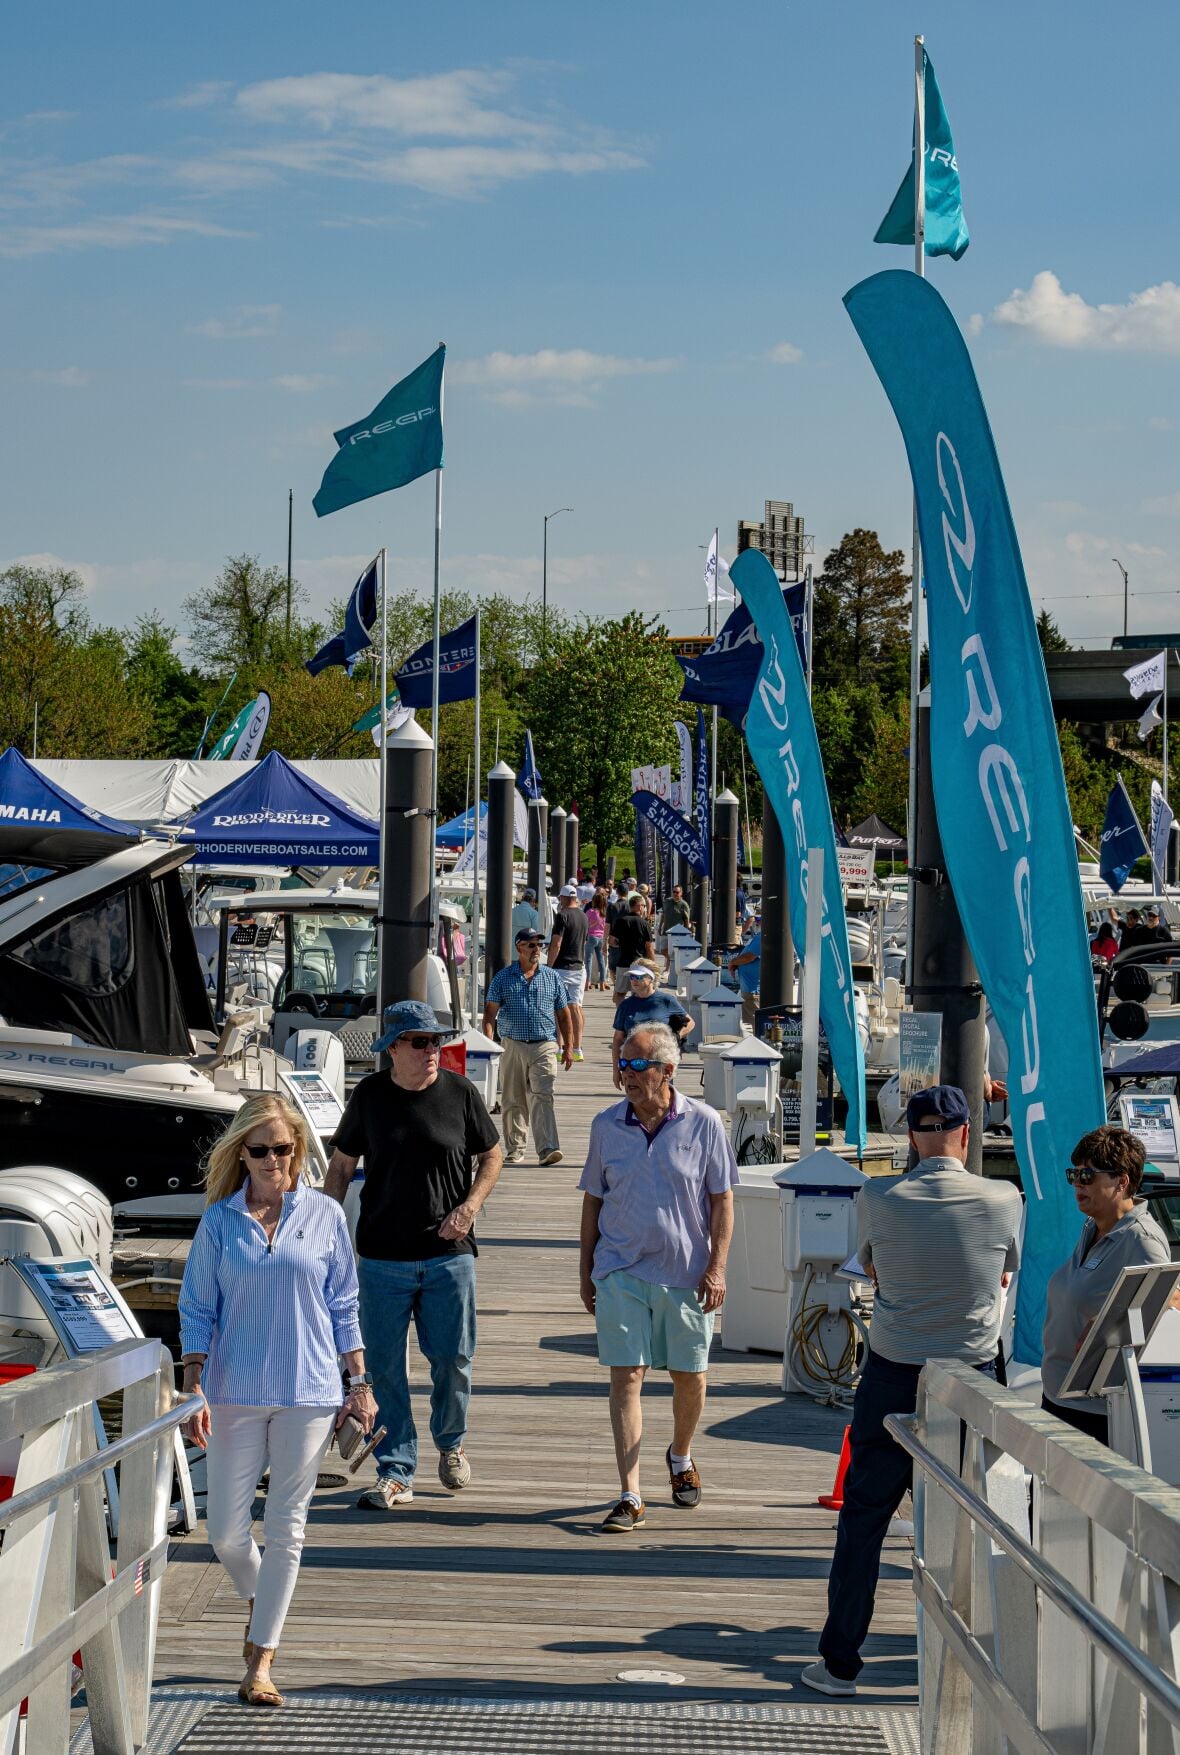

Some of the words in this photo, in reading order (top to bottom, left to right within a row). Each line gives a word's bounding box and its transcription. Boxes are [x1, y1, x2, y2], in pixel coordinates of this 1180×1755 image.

[0, 804, 61, 823] MAHA
[212, 812, 273, 827] RHODE
[276, 811, 332, 827] RIVER
[651, 798, 701, 851] MARINE
[646, 804, 700, 866] BOSUN'S
[194, 843, 368, 856] RHODERIVERBOATSALES.COM
[961, 633, 1046, 1200] REGAL
[28, 1054, 126, 1074] REGAL
